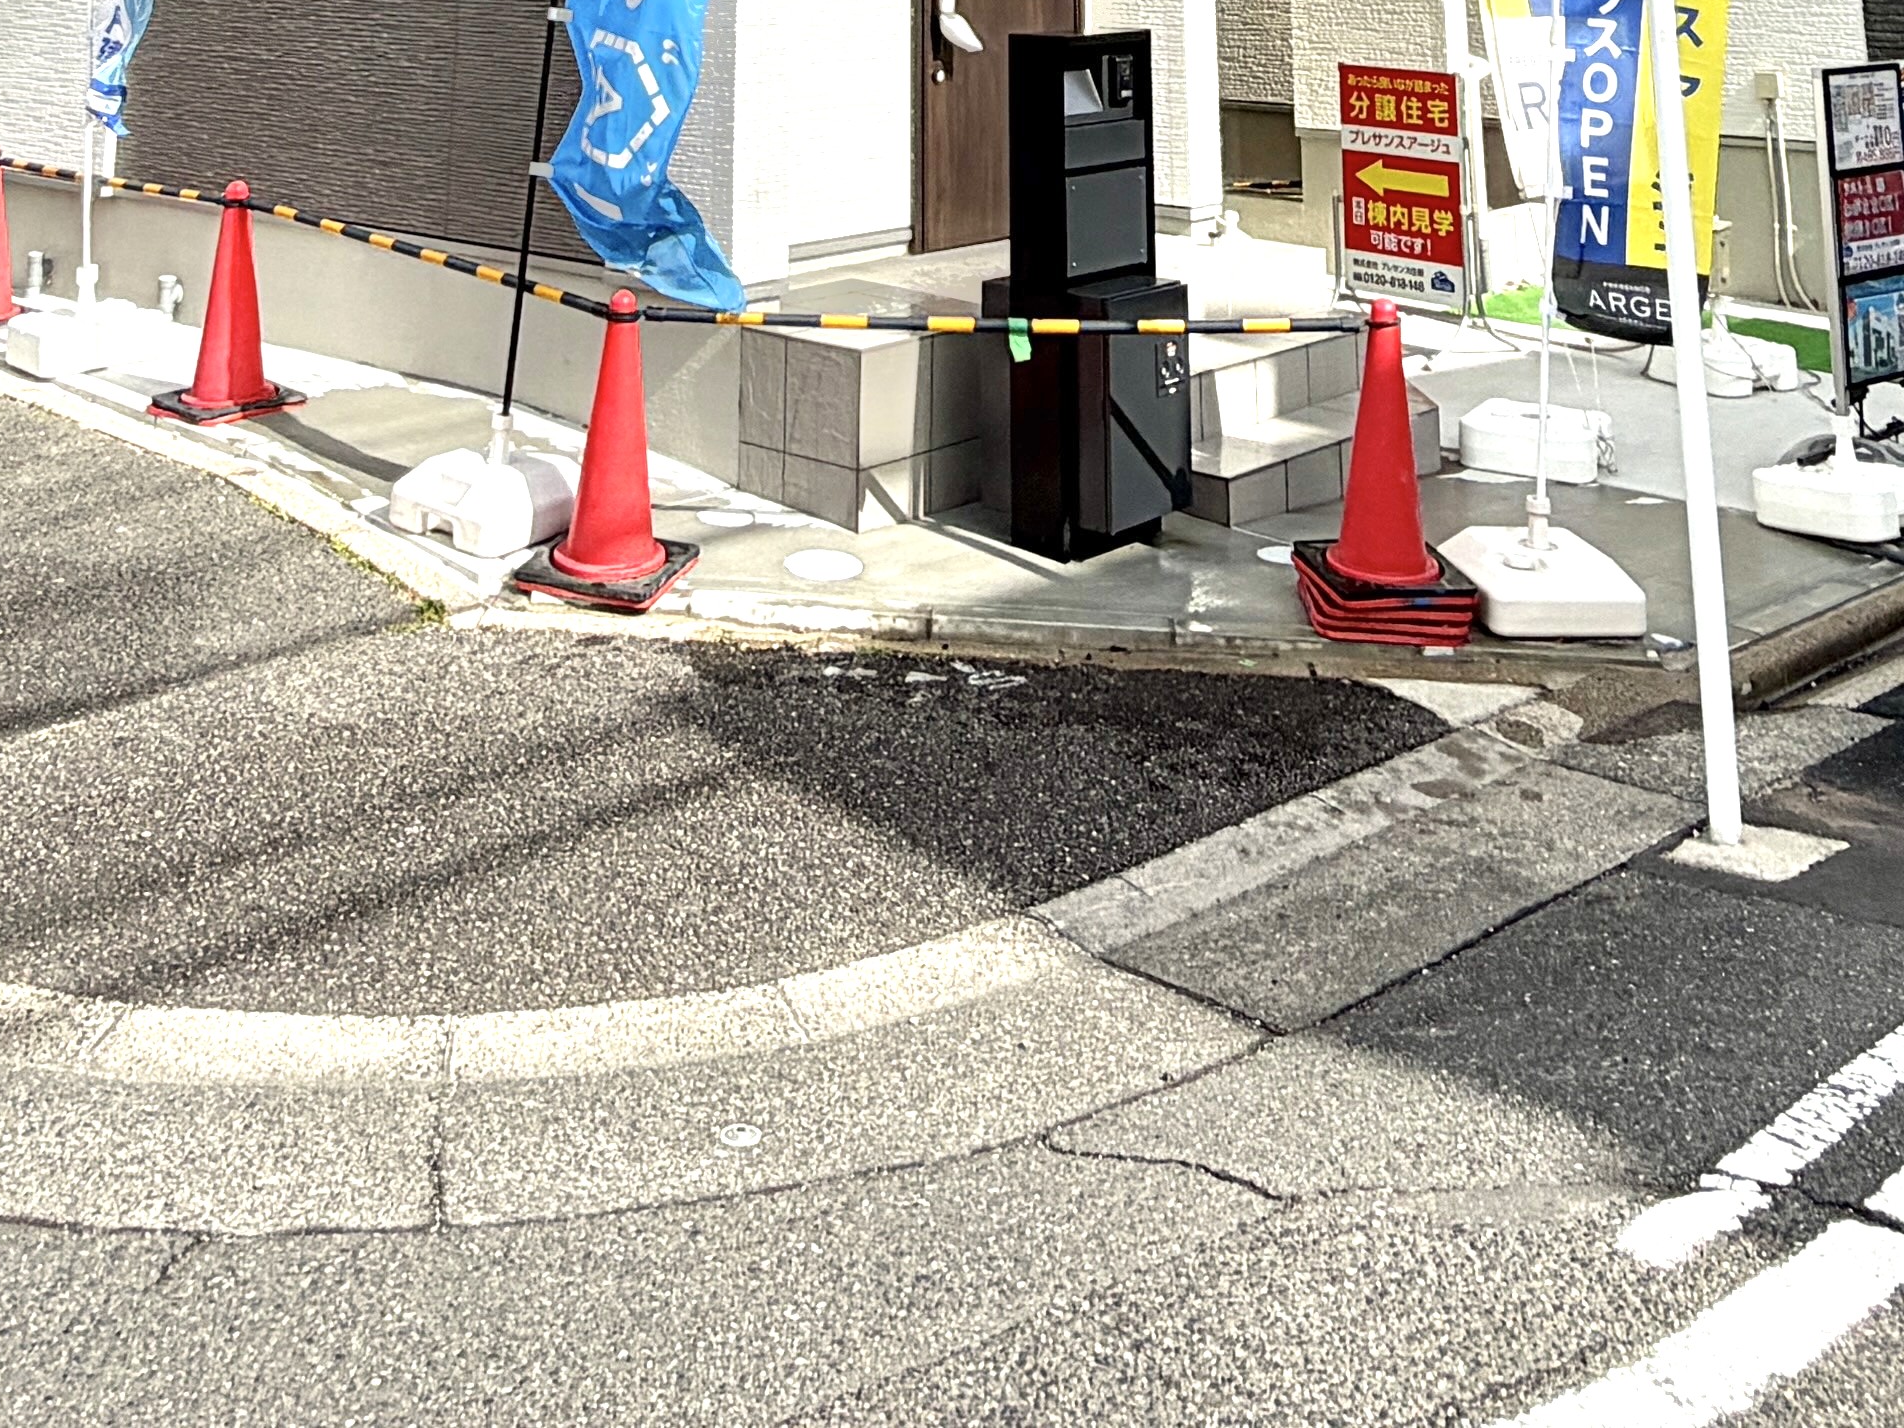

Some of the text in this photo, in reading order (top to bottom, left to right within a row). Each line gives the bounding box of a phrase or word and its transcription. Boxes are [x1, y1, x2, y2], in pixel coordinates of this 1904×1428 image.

[1348, 91, 1450, 128] 分譲住宅
[1348, 129, 1452, 155] プレサンスアージュ
[1367, 199, 1454, 237] 棟内見学
[1588, 288, 1672, 322] ARGE
